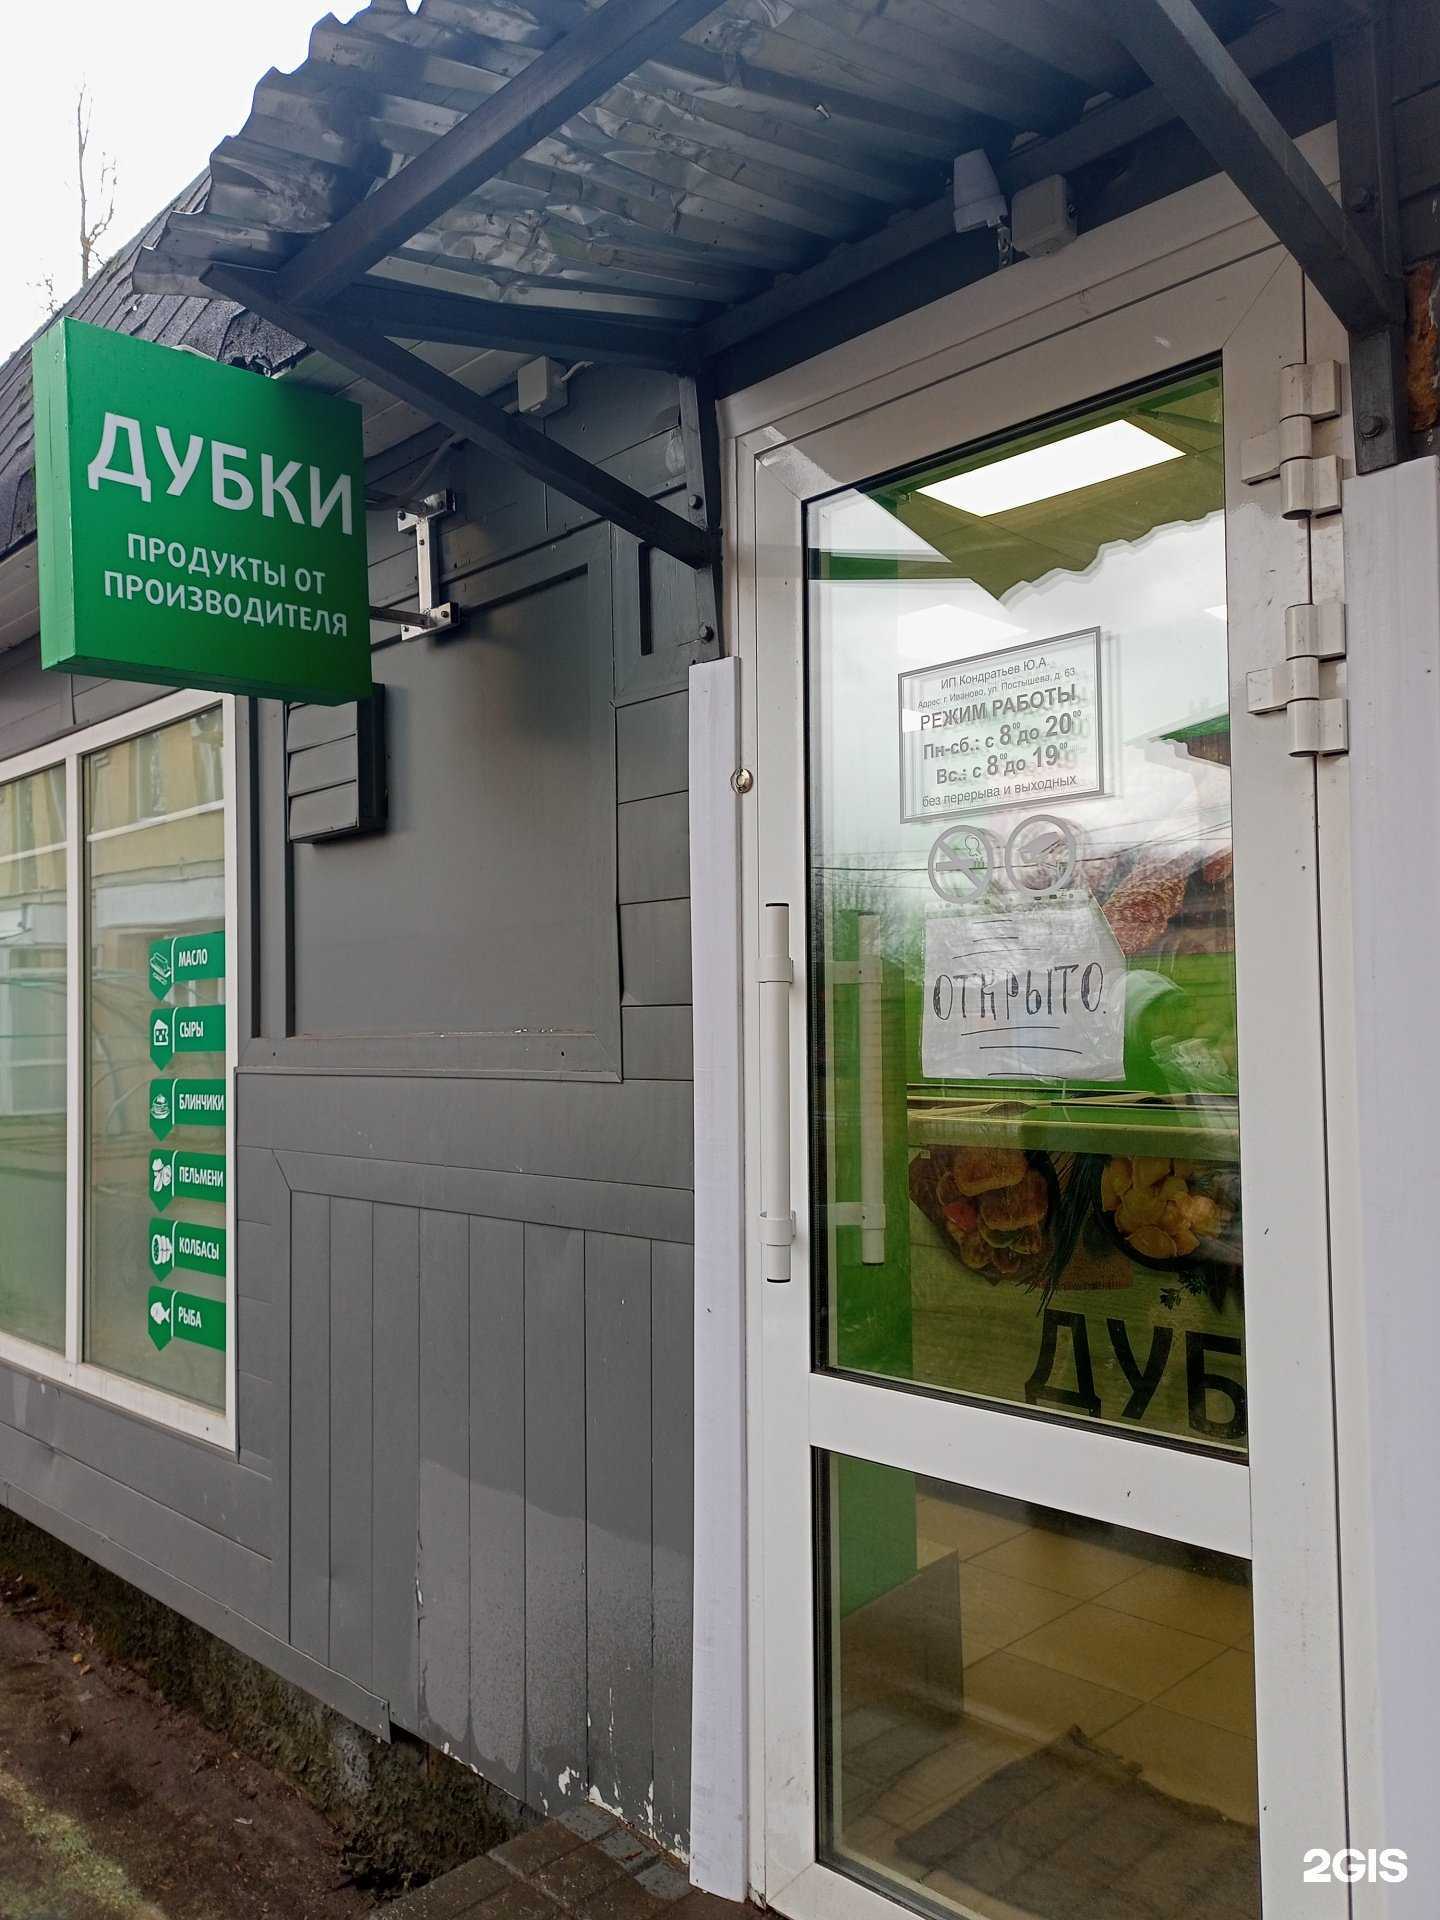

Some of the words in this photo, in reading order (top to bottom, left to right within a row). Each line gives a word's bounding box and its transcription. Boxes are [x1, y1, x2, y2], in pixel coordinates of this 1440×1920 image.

[88, 412, 353, 536] ДУБКИ
[127, 533, 286, 589] ПРОДУКТЫ
[295, 567, 326, 595] ОТ
[104, 571, 348, 637] ПРОИЗВОДИТЕЛЯ
[941, 676, 957, 689] ИП
[959, 664, 1021, 686] Кондратьев
[920, 702, 987, 731] РЕЖИМ
[992, 683, 1076, 717] РАБОТЫ
[985, 736, 995, 748] с
[1016, 727, 1040, 746] до
[972, 765, 982, 779] с
[1004, 758, 1026, 776] до
[922, 795, 941, 807] без
[944, 786, 1000, 804] перерыва
[1003, 785, 1011, 795] и
[1014, 775, 1078, 794] выходных
[178, 948, 208, 967] МАСЛО
[179, 1021, 204, 1038] СЫРЫ
[179, 1093, 225, 1111] БЛИНЧИКИ
[179, 1166, 224, 1188] ПЕЛЬМЕНИ
[178, 1238, 220, 1260] КОЛБАСЫ
[178, 1306, 202, 1328] РЫБА
